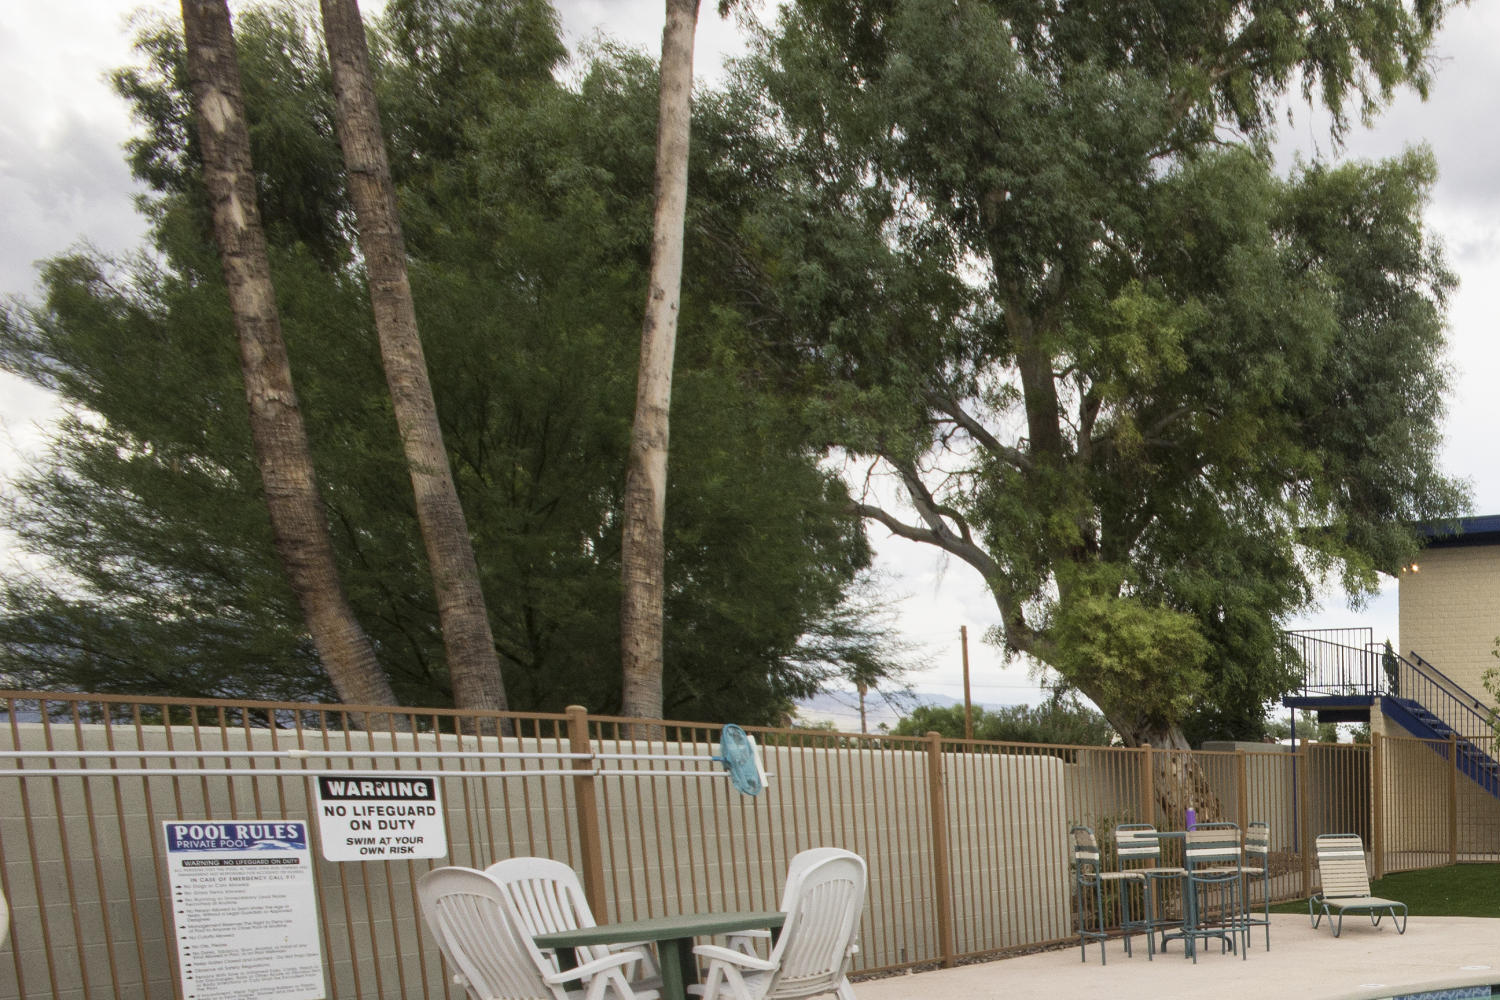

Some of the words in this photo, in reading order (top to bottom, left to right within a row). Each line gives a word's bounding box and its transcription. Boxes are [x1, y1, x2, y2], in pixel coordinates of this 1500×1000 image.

[328, 781, 428, 797] WARNING
[324, 806, 347, 816] NO
[353, 806, 436, 816] LIFEGUARD
[350, 820, 372, 830] ON
[378, 819, 416, 830] DUTY
[174, 825, 230, 840] POOL
[236, 824, 299, 839] RULES
[176, 839, 217, 848] PRIVATE
[220, 839, 249, 848] POOL
[346, 837, 376, 846] SWIM
[379, 837, 392, 845] AT
[395, 836, 424, 844] YOUR
[360, 847, 385, 855] OWN
[389, 846, 415, 854] RISK
[183, 859, 220, 867] WARNING
[235, 858, 270, 866] LIFEGUARD
